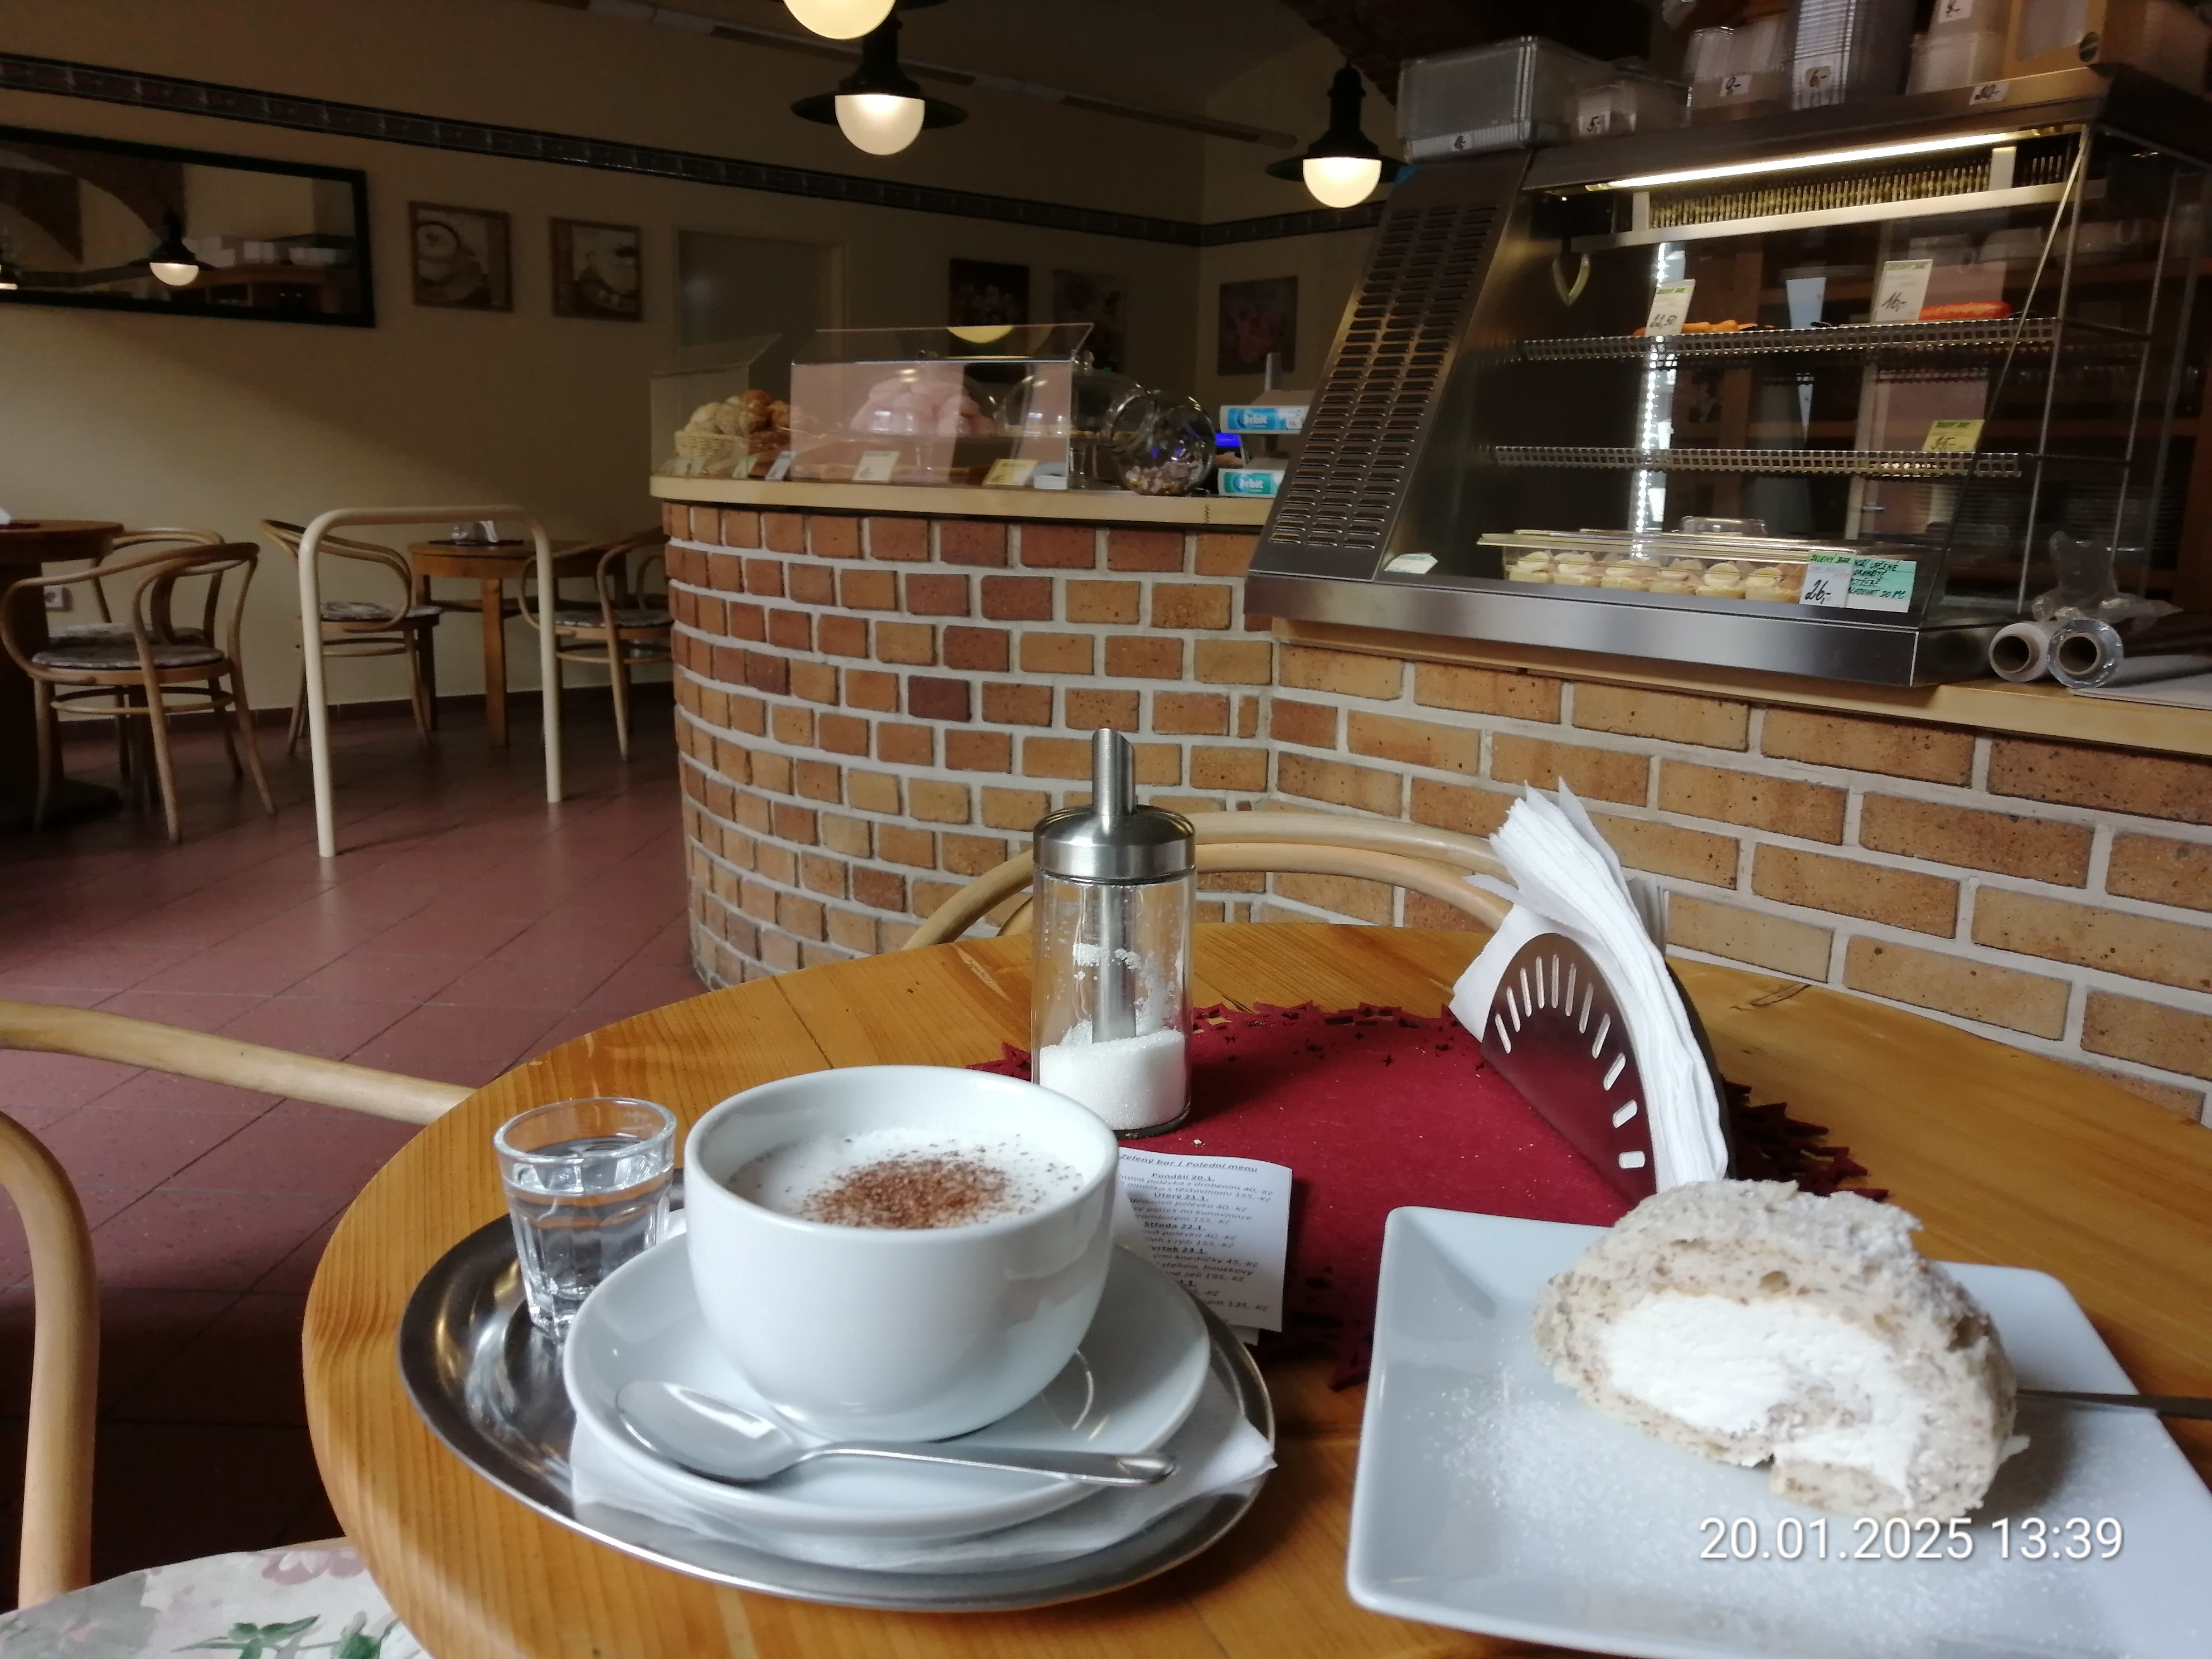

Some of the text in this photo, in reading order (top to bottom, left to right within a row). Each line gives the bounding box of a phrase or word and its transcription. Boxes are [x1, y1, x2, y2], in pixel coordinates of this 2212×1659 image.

[1804, 579, 1831, 604] 26,-
[1119, 1153, 1154, 1164] Zelený
[1186, 1161, 1226, 1169] Polední
[1228, 1164, 1258, 1172] menu
[1185, 1194, 1209, 1202] 21.1.
